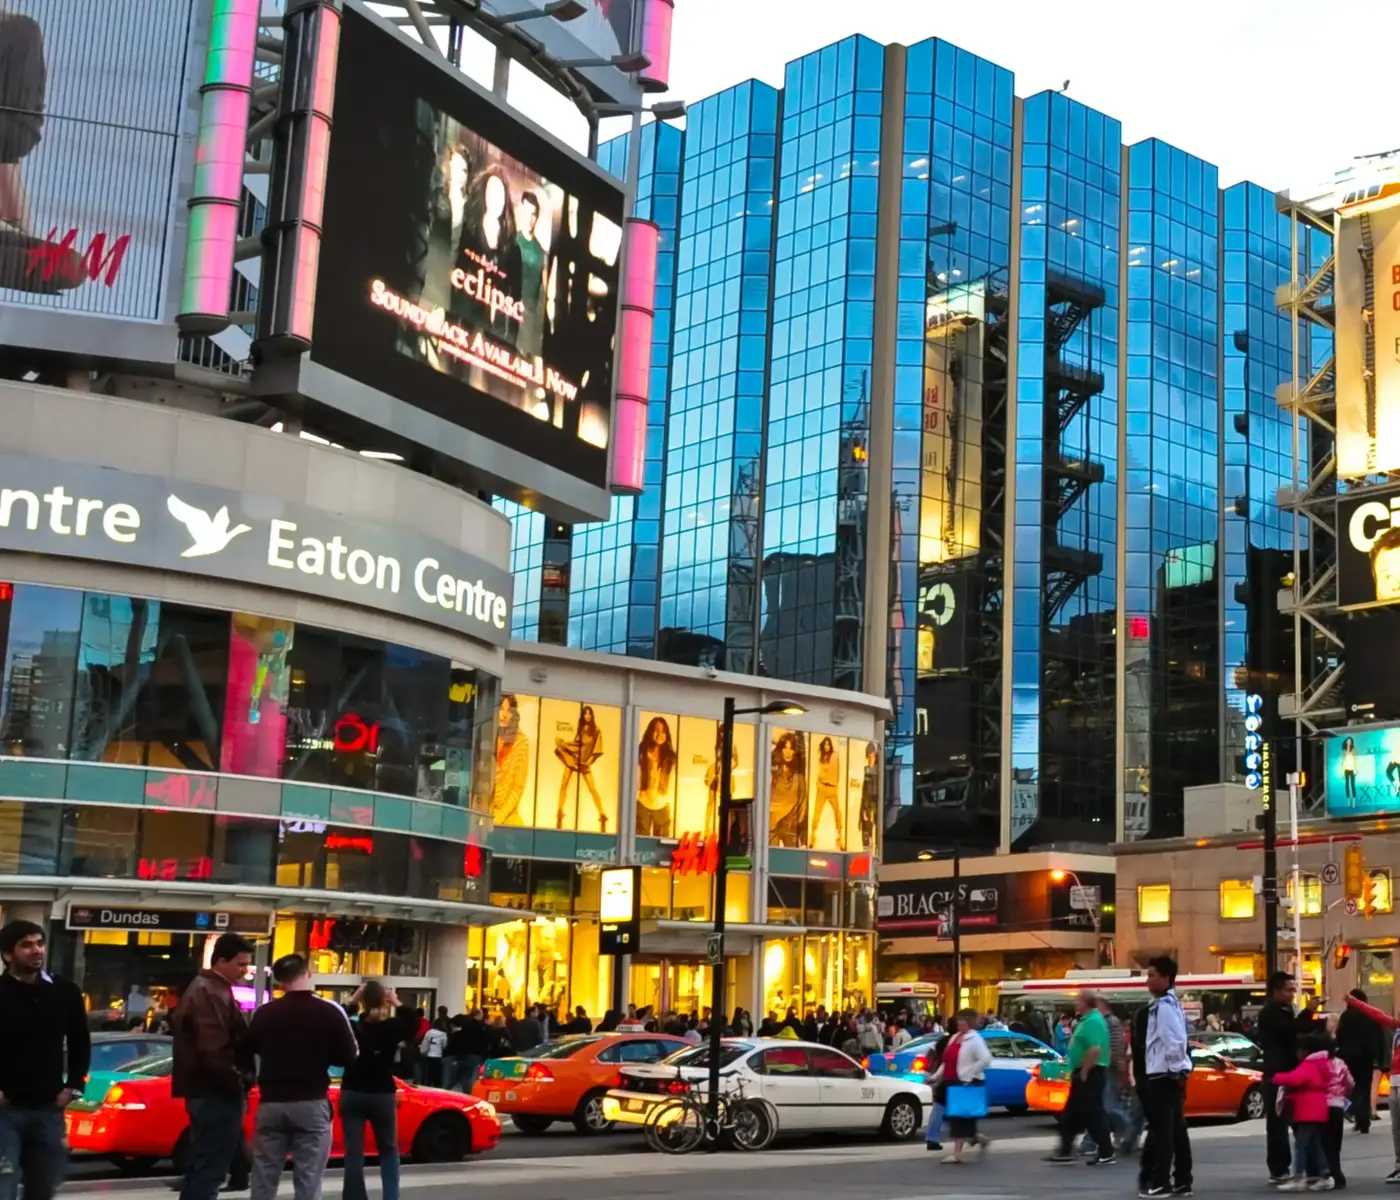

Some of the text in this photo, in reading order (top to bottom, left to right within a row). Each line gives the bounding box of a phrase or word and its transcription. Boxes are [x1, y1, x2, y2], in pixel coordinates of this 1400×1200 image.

[450, 267, 525, 324] eclipse
[267, 518, 401, 594] Eaton
[413, 556, 508, 630] Centre
[1262, 742, 1270, 811] DOWNTOWN
[100, 910, 160, 925] Dundas
[897, 884, 967, 916] BLACS
